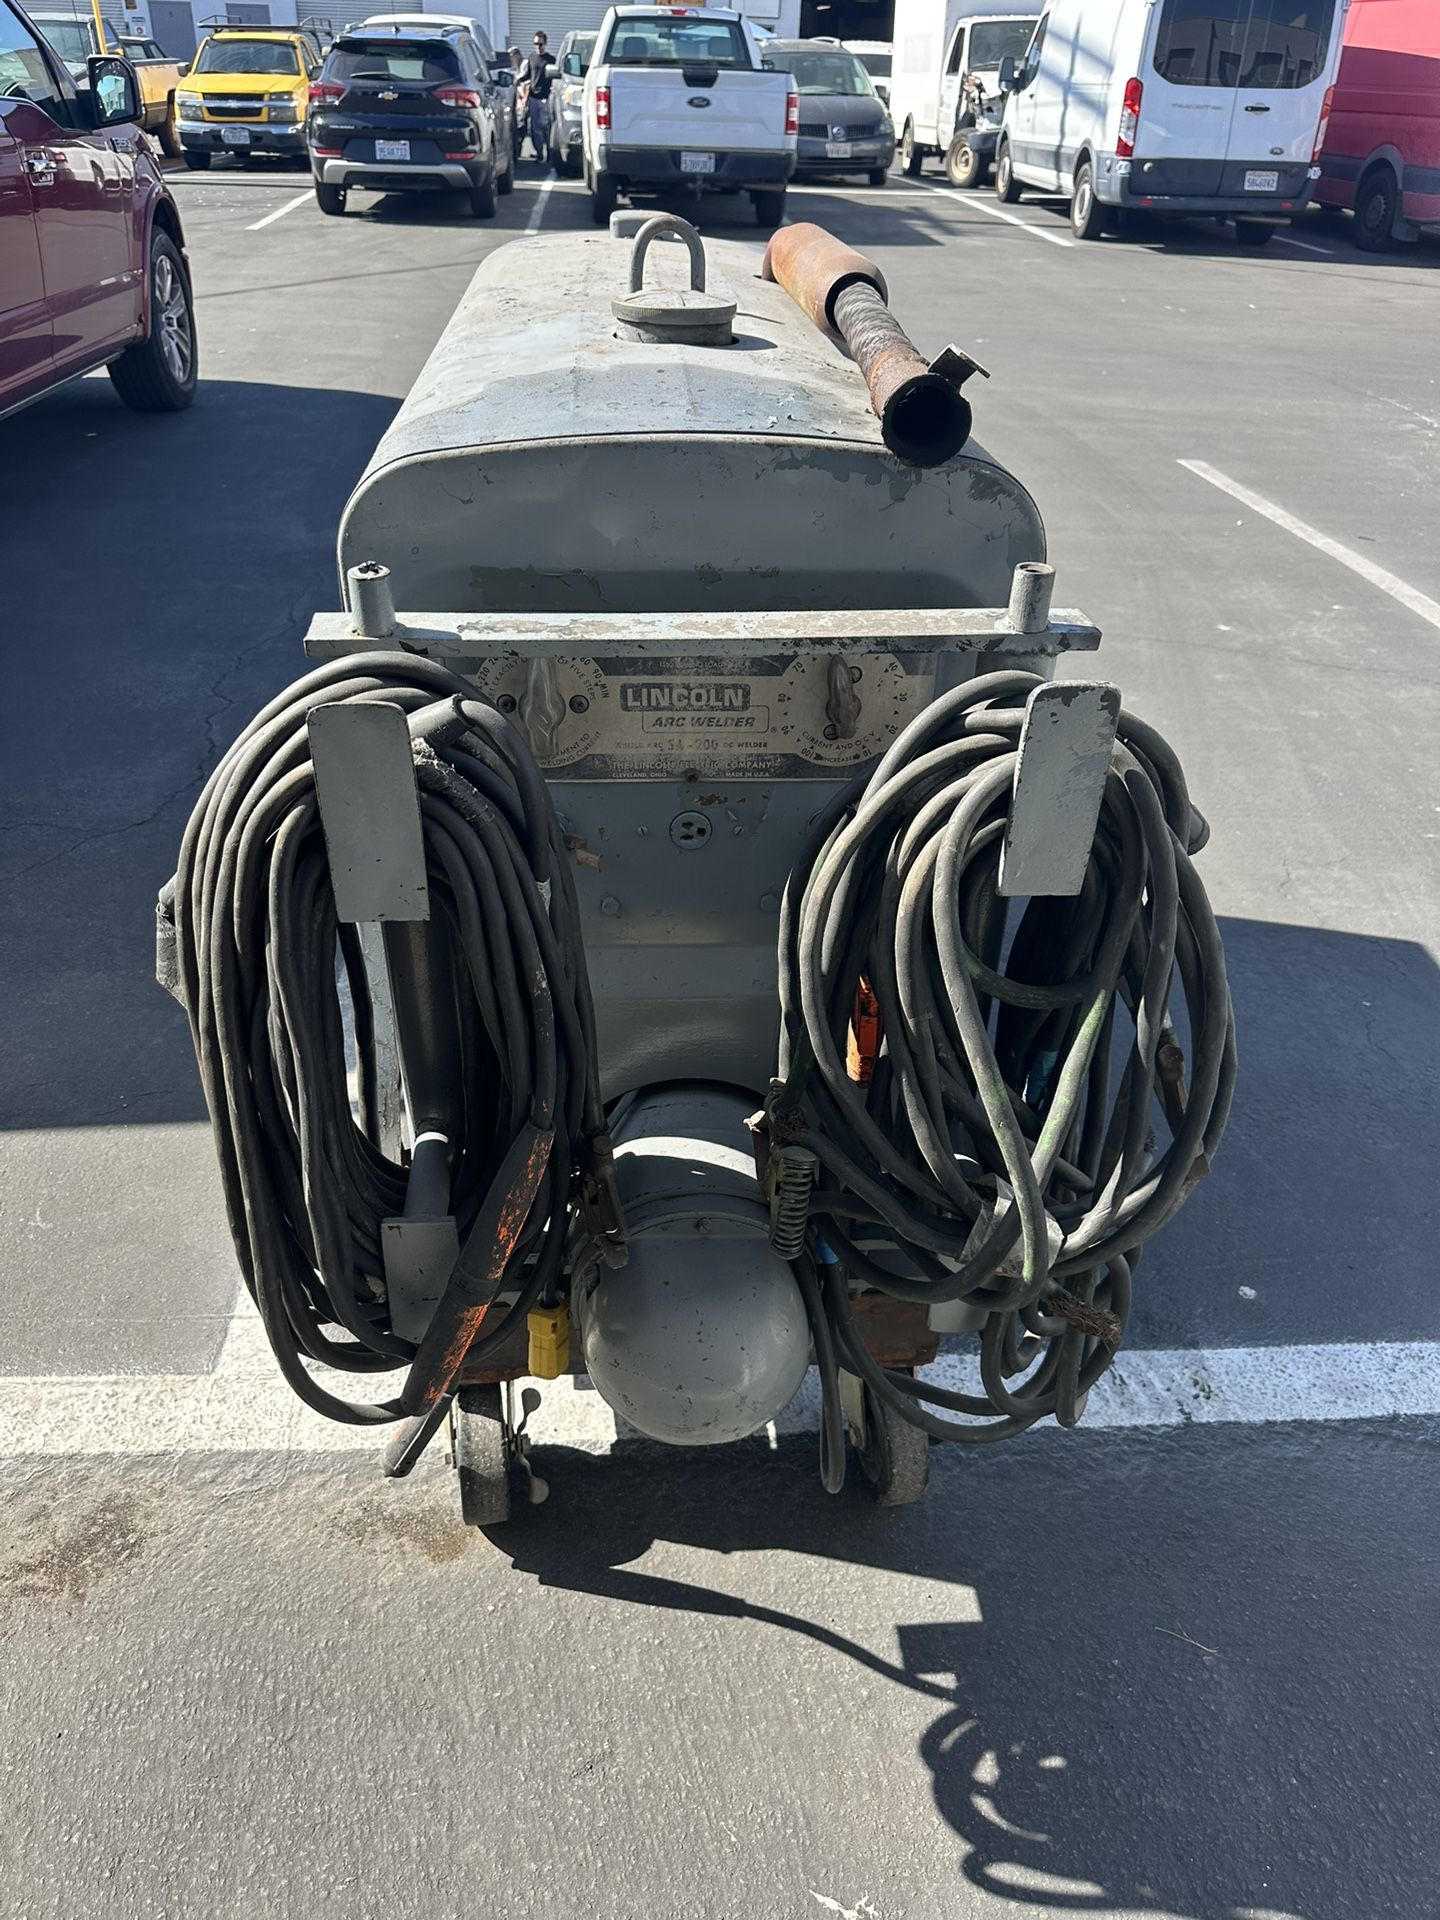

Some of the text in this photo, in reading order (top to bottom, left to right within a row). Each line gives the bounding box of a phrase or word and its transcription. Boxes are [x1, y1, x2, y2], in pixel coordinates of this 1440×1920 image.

[792, 662, 803, 672] 70
[888, 661, 899, 672] 40
[569, 664, 586, 680] FIVE
[583, 679, 596, 701] STEPS
[626, 688, 743, 706] LINCOLN
[652, 717, 756, 728] ARC WELDER
[580, 733, 590, 742] TO
[802, 731, 832, 750] CURRENT
[835, 743, 853, 751] AND
[540, 731, 602, 766] WELDING CURRENT
[801, 748, 814, 758] 100
[863, 749, 872, 757] 10
[613, 761, 630, 769] THE
[725, 761, 771, 769] COMPANY
